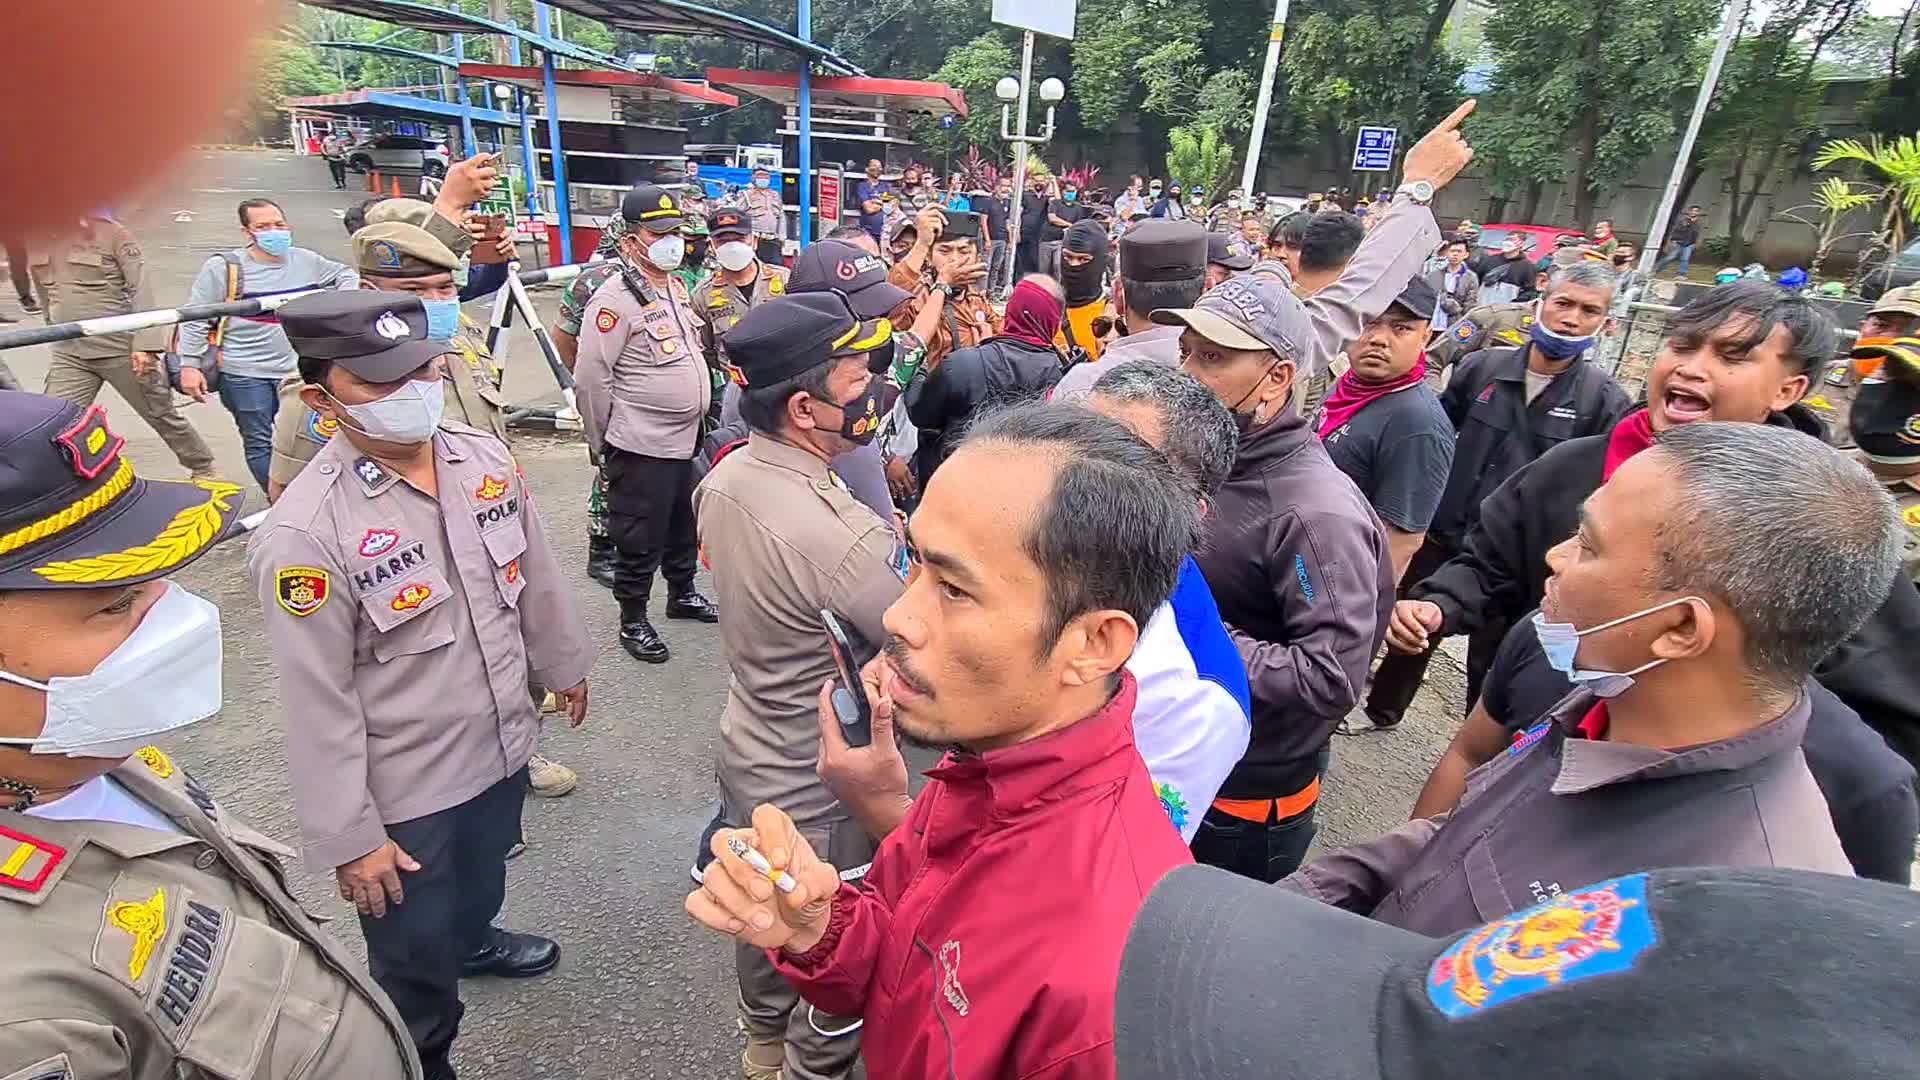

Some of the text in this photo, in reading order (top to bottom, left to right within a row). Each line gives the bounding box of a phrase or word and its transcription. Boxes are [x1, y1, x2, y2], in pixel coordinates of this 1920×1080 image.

[475, 497, 519, 529] POLRI
[354, 543, 426, 591] HARRY
[156, 900, 221, 1027] HENDRA
